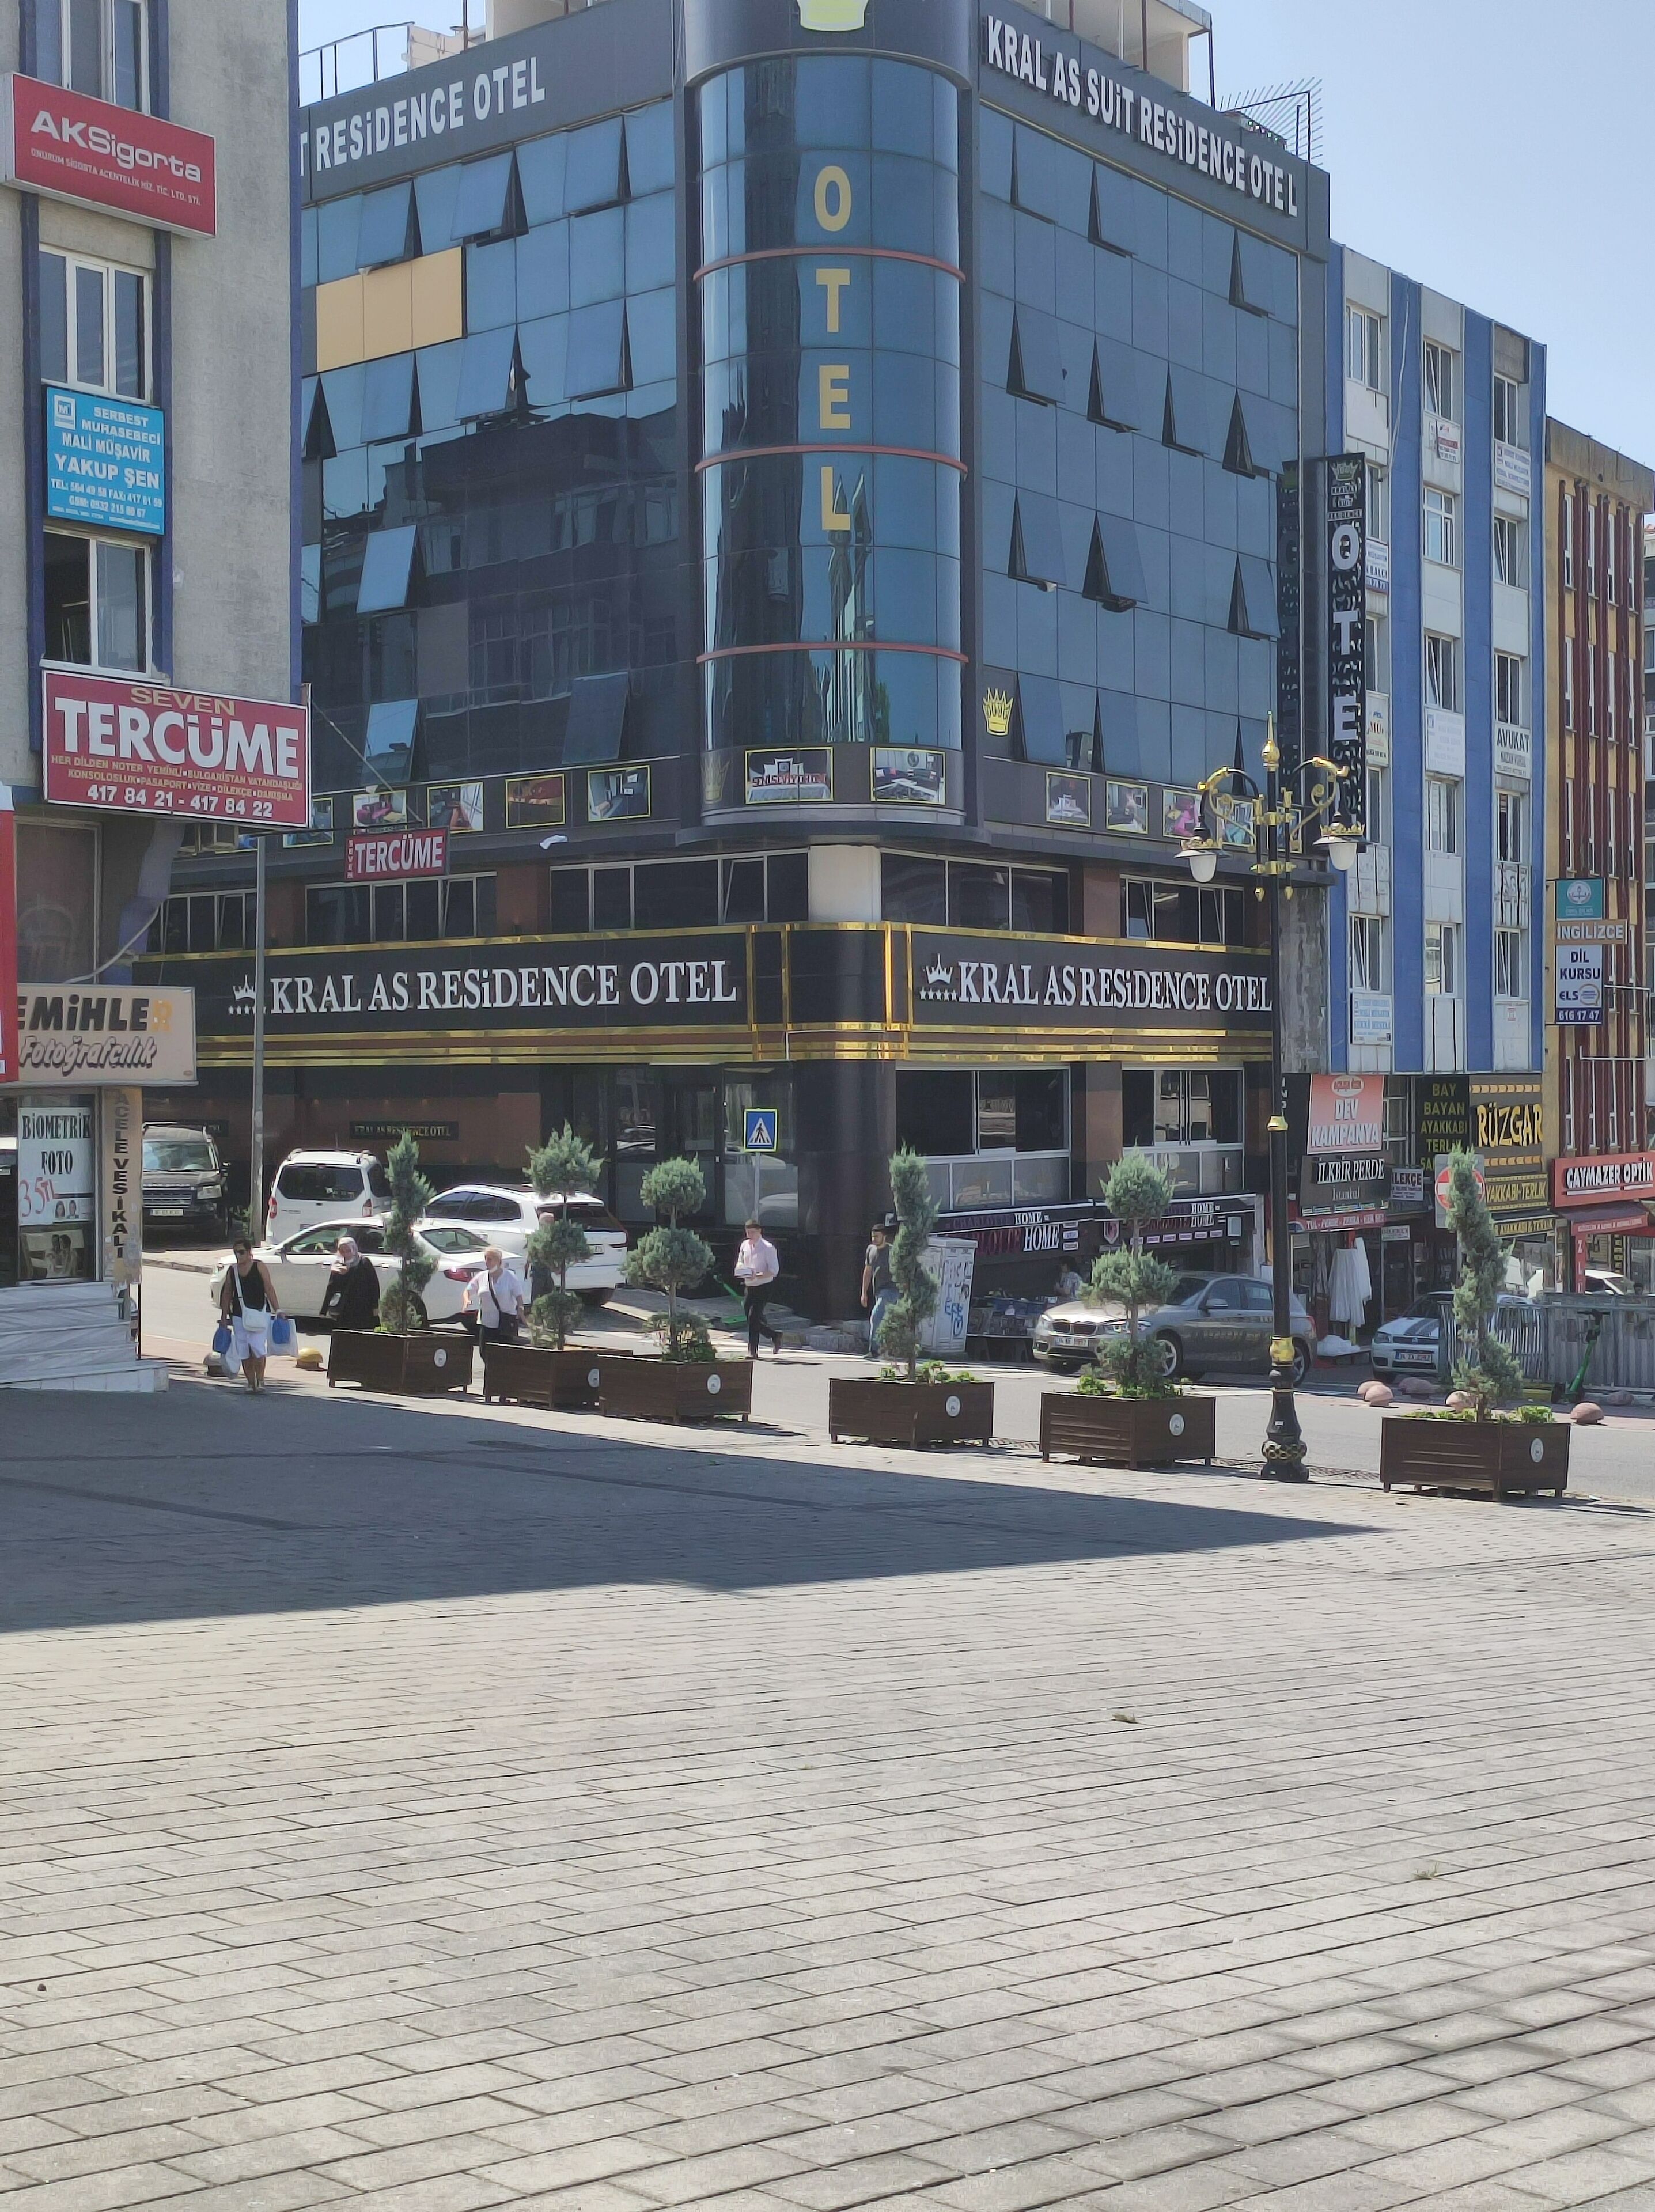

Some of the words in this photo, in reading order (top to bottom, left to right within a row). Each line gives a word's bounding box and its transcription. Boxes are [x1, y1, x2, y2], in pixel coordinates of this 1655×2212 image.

[474, 56, 546, 120] OTEL
[987, 14, 1047, 91] KRAL
[1053, 51, 1081, 107] AS
[1250, 154, 1298, 218] OTEL
[31, 110, 201, 183] AKSigorta
[814, 165, 851, 531] OTEL
[94, 407, 149, 427] SERBEST
[81, 419, 161, 445] MUHASEBECİ
[62, 432, 92, 451] MALİ
[95, 438, 150, 463] MÜŞAVİR
[54, 453, 118, 480] YAKUP
[124, 467, 160, 490] ŞEN
[130, 687, 235, 717] SEVEN
[55, 696, 299, 779] TERCÜME
[1497, 728, 1529, 753] AVUKAT
[51, 755, 71, 765] HER
[74, 756, 109, 770] DİLDEN
[68, 769, 137, 784] KONSOLOSLUK
[192, 781, 211, 793] VİZE
[88, 784, 118, 802] 417
[124, 787, 147, 805] 84
[154, 790, 173, 807] 21
[190, 794, 219, 812] 417
[225, 797, 245, 815] 84
[252, 801, 272, 818] 22
[354, 834, 443, 874] TERCÜME
[1557, 922, 1624, 940] İNGİLİZCE
[1571, 948, 1590, 964] DİL
[270, 975, 361, 1014] KRAL
[368, 972, 409, 1012] AS
[630, 960, 737, 1005] OTEL
[957, 961, 1039, 1005] KRAL
[1043, 965, 1077, 1007] AS
[1215, 973, 1273, 1012] OTEL
[1559, 968, 1600, 980] KURSU
[1559, 990, 1578, 1001] ELS
[1432, 1083, 1457, 1097] BAY
[1334, 1098, 1359, 1120] DEV
[1423, 1101, 1465, 1116] BAYAN
[115, 1093, 130, 1154] ACELE
[1311, 1123, 1379, 1149] KAMPANYA
[1421, 1120, 1468, 1135] AYAKKABI
[1476, 1101, 1544, 1147] RÜZGAR
[41, 1150, 73, 1175] FOTO
[1317, 1155, 1351, 1185] İLKBİR
[1352, 1158, 1385, 1181] PERDE
[1623, 1157, 1653, 1183] OPTİK
[112, 1158, 130, 1259] VESİKALI
[1014, 1211, 1043, 1225] HOME
[1191, 1202, 1214, 1214] HOME
[1191, 1215, 1214, 1228] HOME
[1023, 1224, 1060, 1252] HOME
